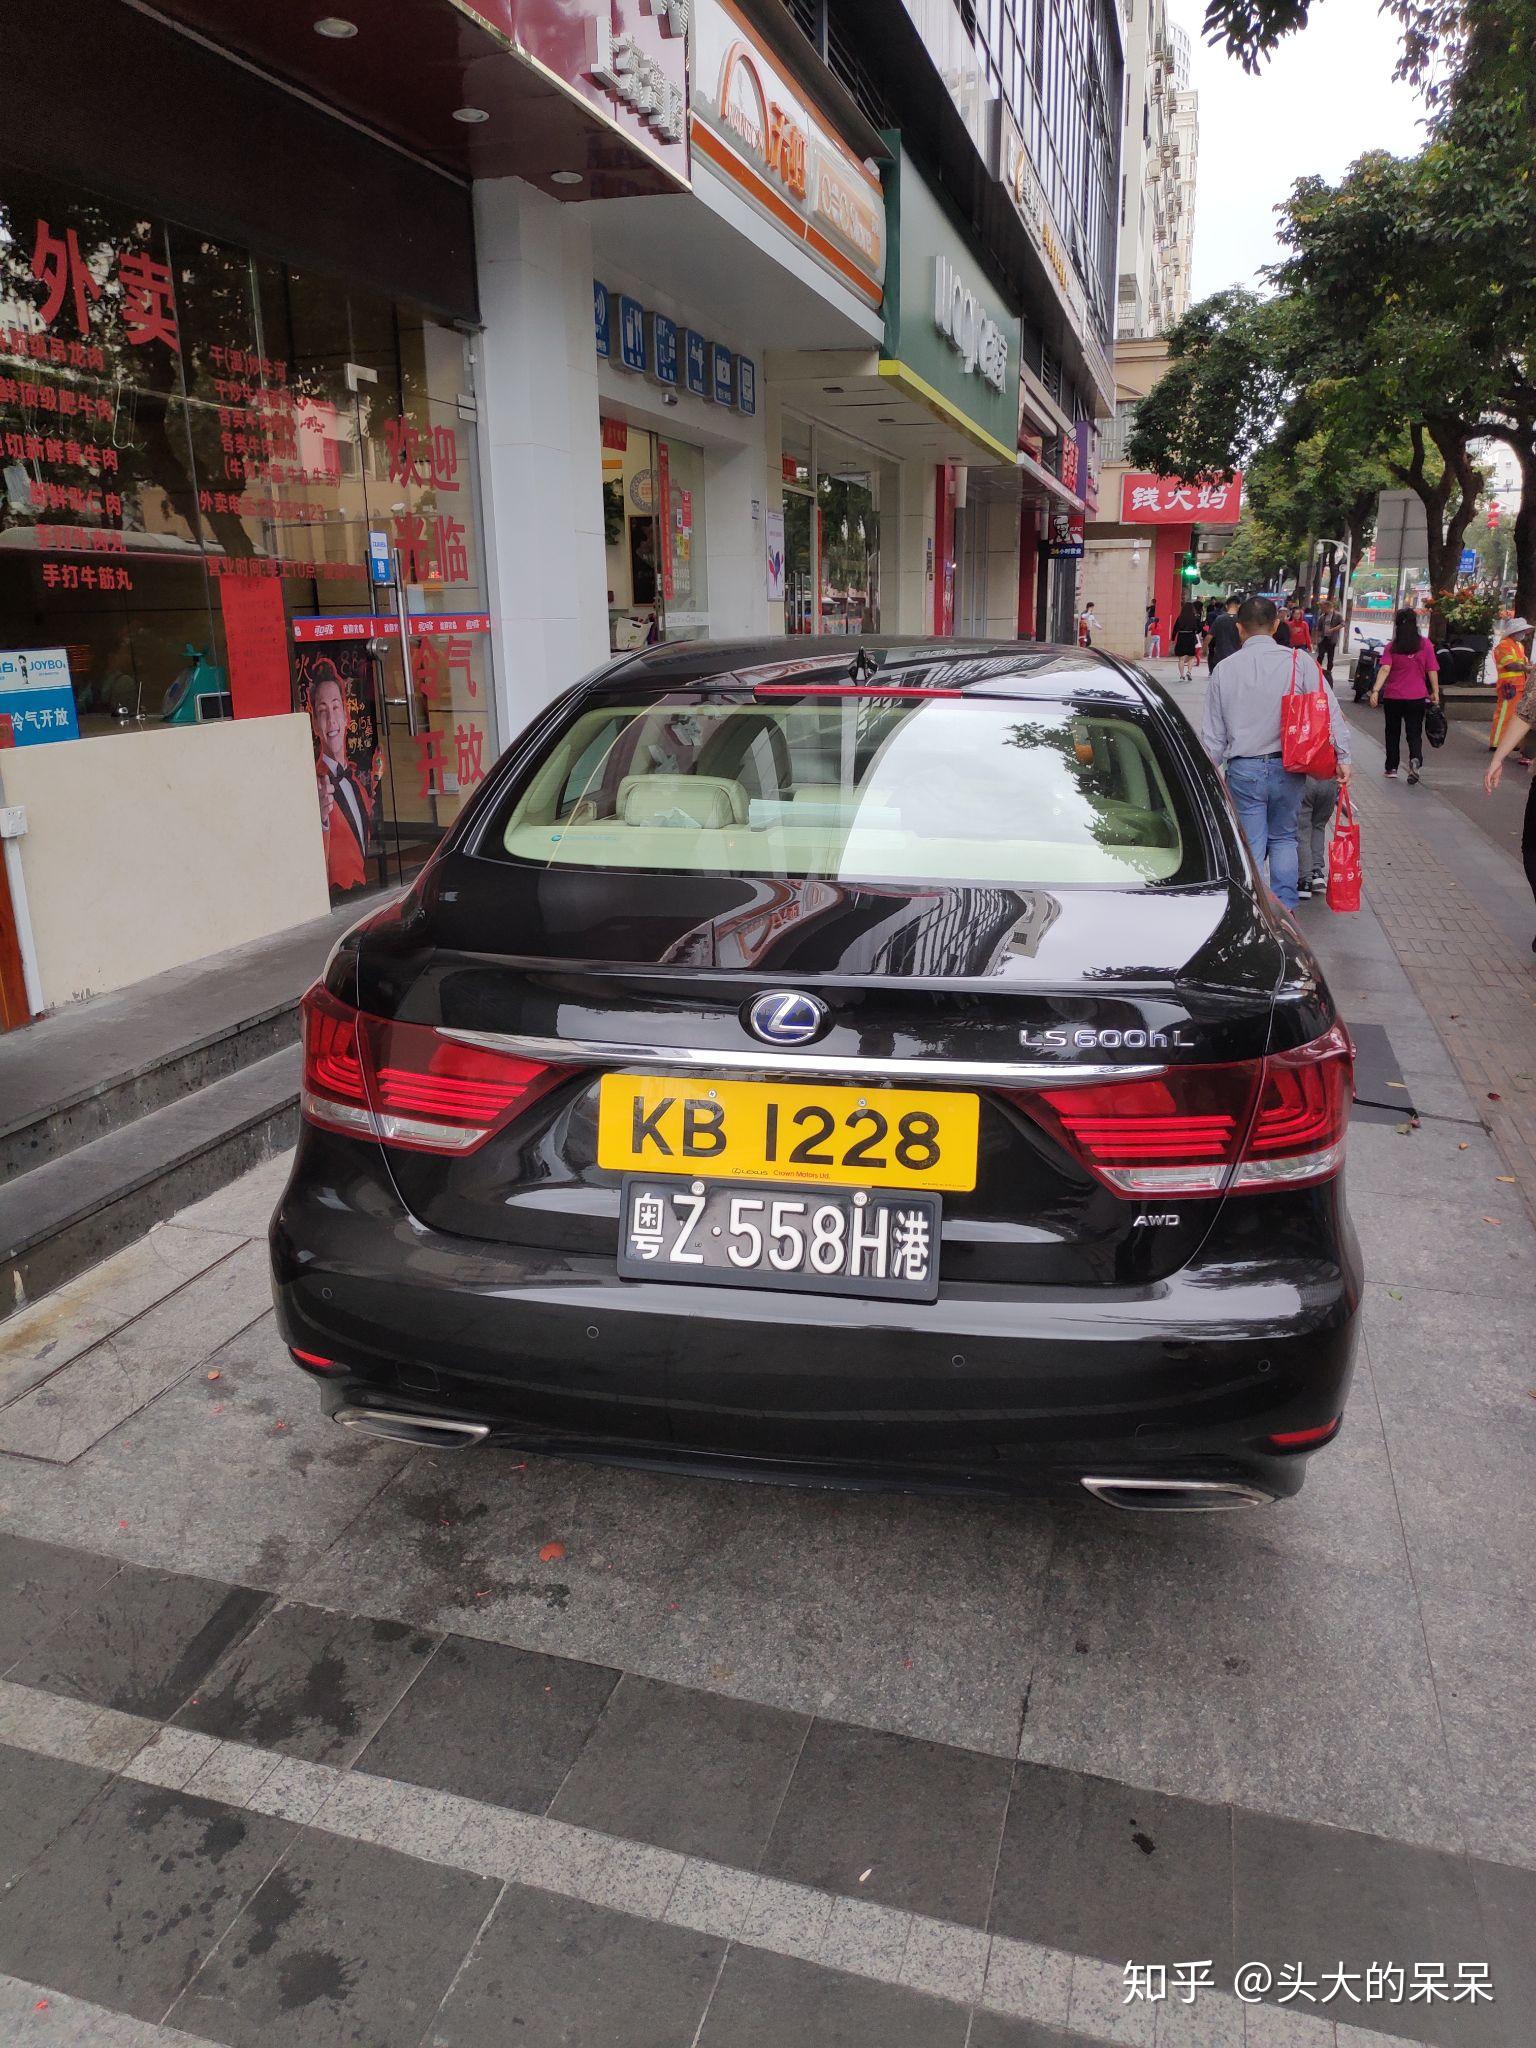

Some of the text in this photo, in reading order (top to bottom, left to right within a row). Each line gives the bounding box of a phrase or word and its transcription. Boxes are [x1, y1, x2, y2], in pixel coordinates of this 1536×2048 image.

[32, 219, 180, 352] 外卖
[0, 432, 118, 471] 切新鲜黄牛肉
[384, 417, 460, 492] 欢迎
[1132, 485, 1227, 511] 钱大妈
[394, 511, 469, 583] 光临
[42, 563, 133, 591] 手打牛筋丸
[408, 635, 477, 698] 冷气
[11, 707, 70, 731] 冷气开放
[416, 722, 486, 799] 开放
[1018, 1029, 1067, 1048] LS
[631, 1096, 942, 1171] KB 1228
[773, 1169, 794, 1177] Crown
[795, 1171, 818, 1179] Motors
[1132, 1214, 1181, 1228] AWD
